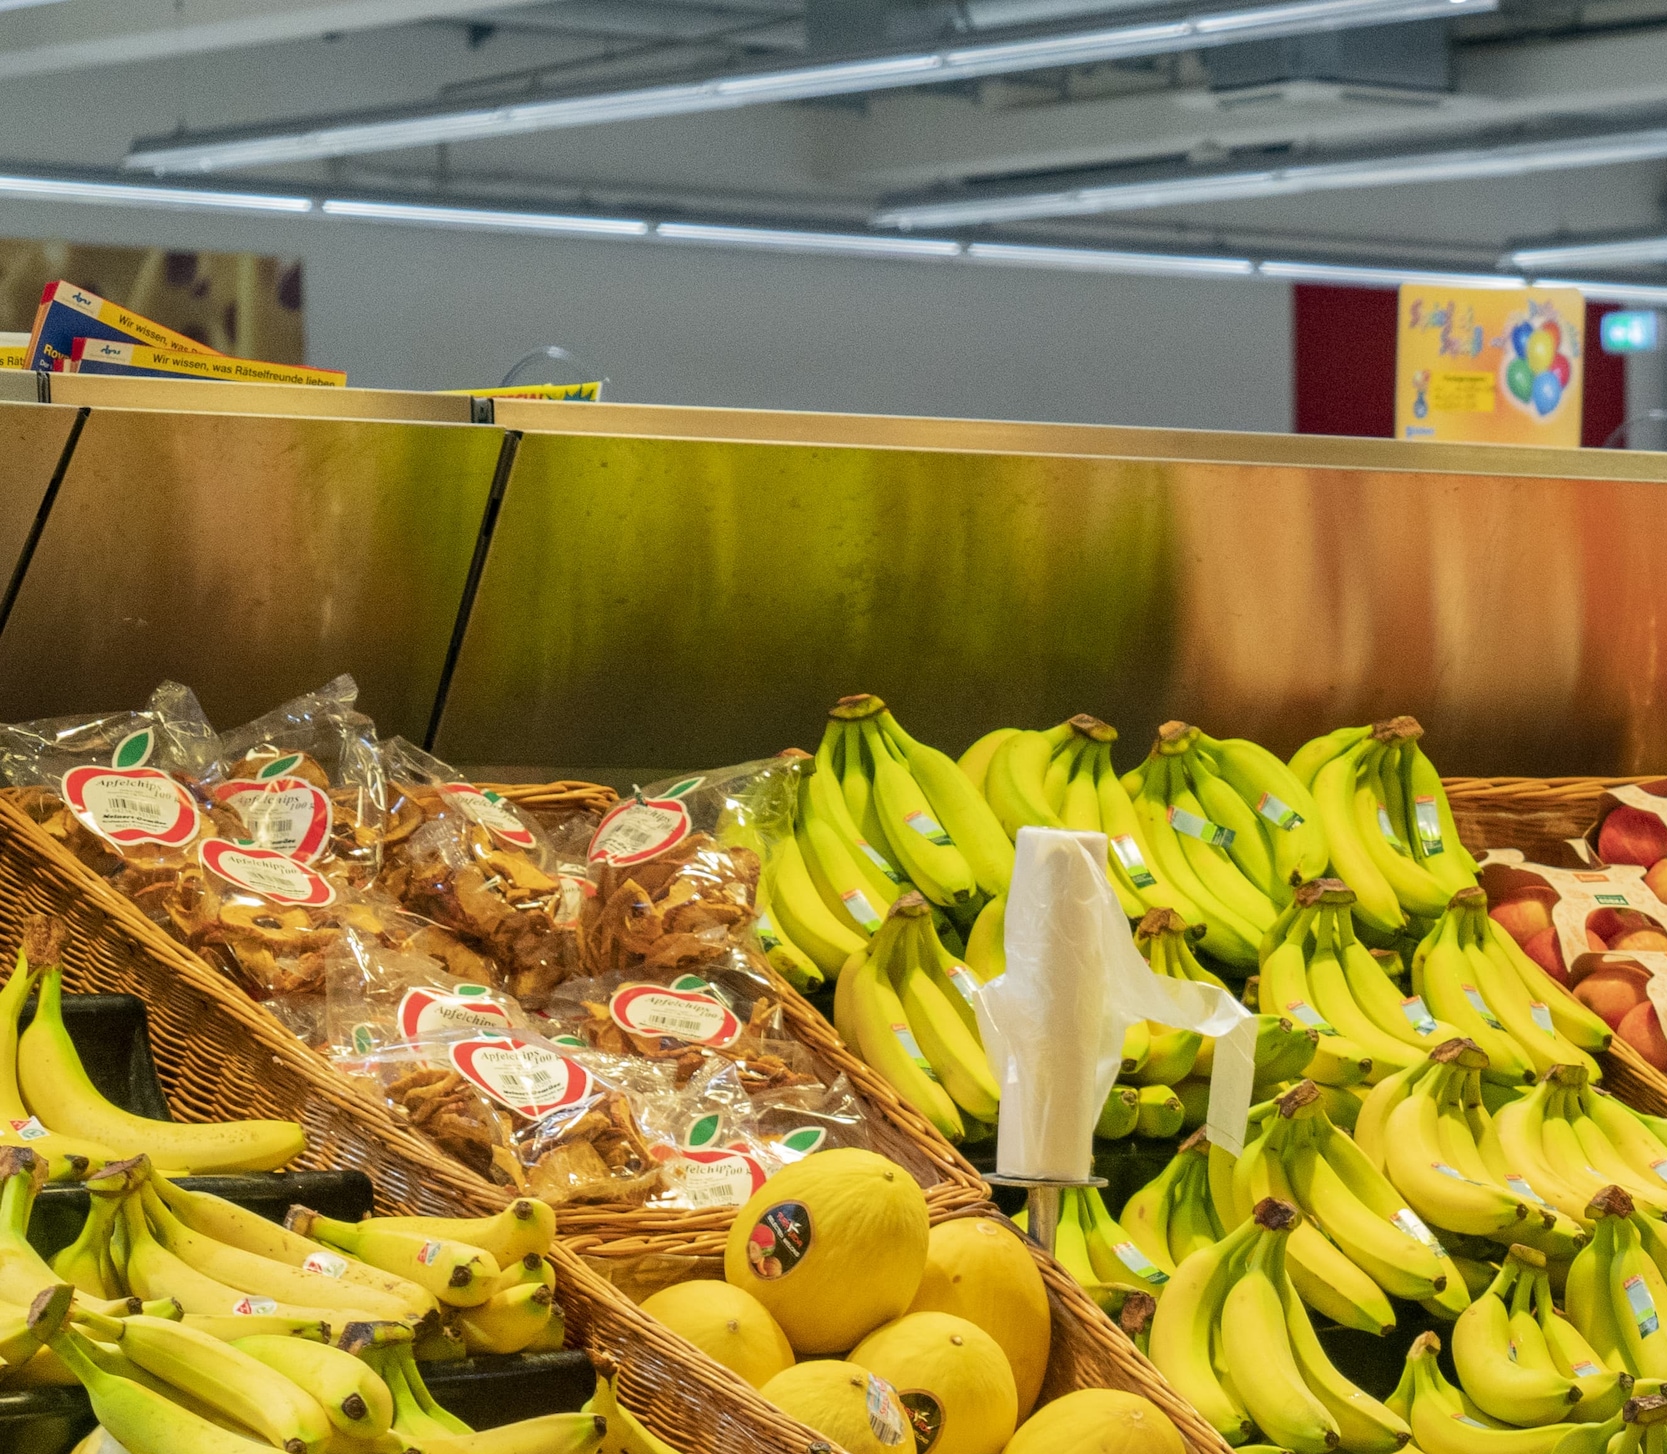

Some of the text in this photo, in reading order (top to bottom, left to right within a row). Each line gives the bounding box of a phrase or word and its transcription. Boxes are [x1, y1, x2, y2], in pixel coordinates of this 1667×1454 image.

[118, 313, 134, 328] Wir
[135, 323, 169, 347] wissen,
[152, 353, 170, 365] Wir
[171, 358, 209, 372] wissen,
[212, 364, 233, 374] was
[234, 364, 304, 385] Rätselfreunde
[95, 779, 162, 792] Apfelchips
[645, 996, 710, 1012] Apfelchips
[685, 1162, 732, 1174] felchips
